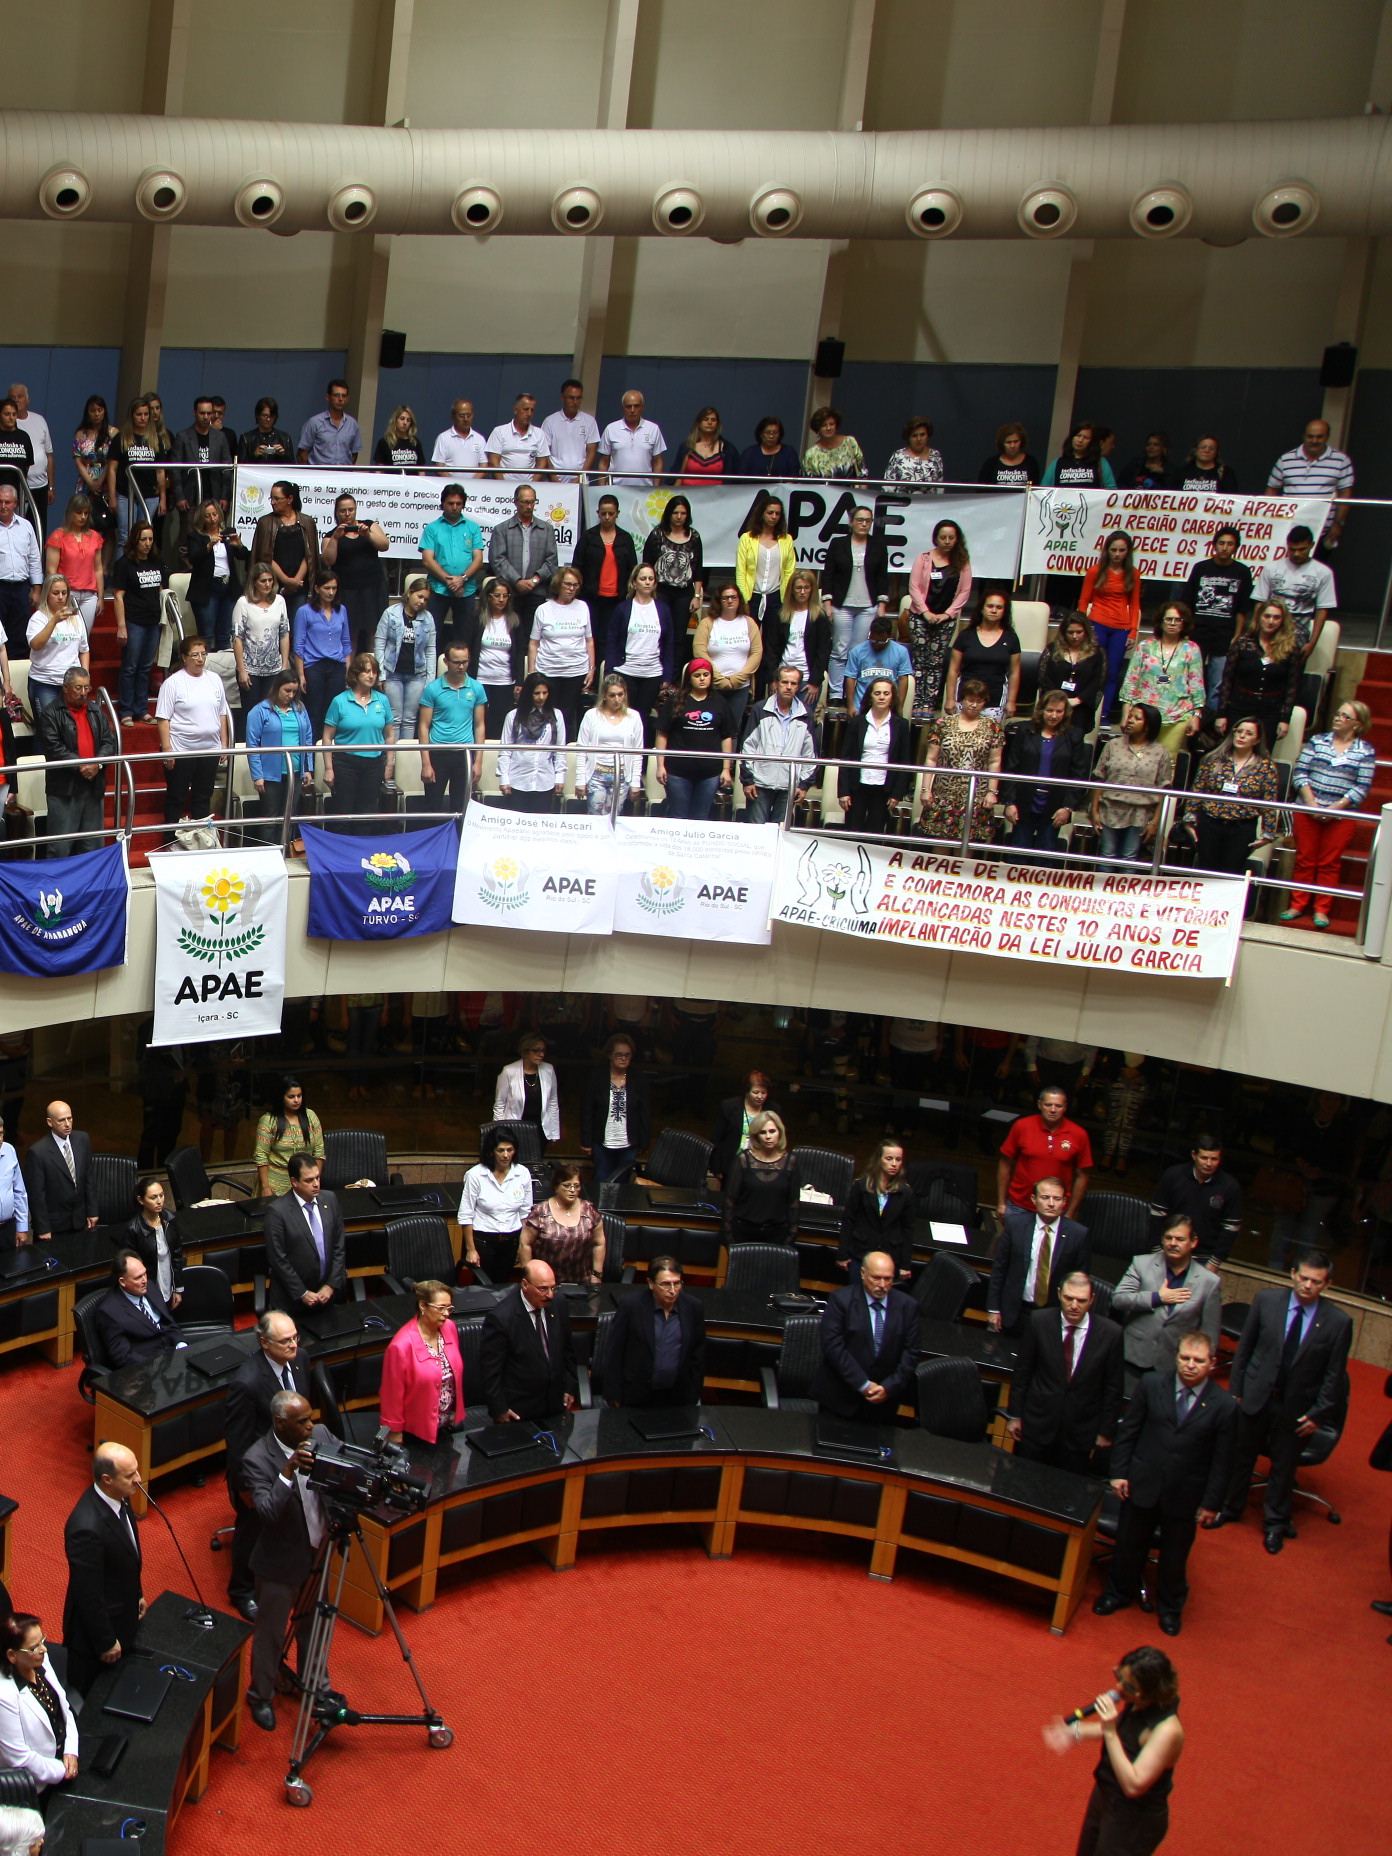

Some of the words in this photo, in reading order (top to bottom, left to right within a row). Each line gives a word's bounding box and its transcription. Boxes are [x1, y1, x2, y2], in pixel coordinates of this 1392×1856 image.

[1060, 472, 1094, 480] CONQUISTA
[303, 496, 312, 504] de
[366, 500, 386, 509] gesto
[325, 485, 337, 494] faz
[341, 486, 369, 495] sozinho:
[373, 489, 402, 498] sempre
[414, 491, 440, 500] preciso
[481, 495, 491, 503] de
[1106, 493, 1119, 508] O
[1123, 493, 1199, 512] CONSELHO
[1203, 497, 1234, 516] DAS
[1242, 501, 1298, 520] APAES
[322, 516, 332, 525] 10
[382, 521, 402, 529] vem
[404, 521, 419, 530] nos
[738, 488, 912, 547] APAE
[1101, 513, 1123, 529] DA
[1125, 514, 1178, 533] REGIÃO
[1045, 540, 1078, 552] APAE
[1176, 539, 1198, 557] OS
[1138, 561, 1158, 577] DA
[1162, 562, 1189, 578] LEI
[480, 815, 512, 827] Amigo
[515, 817, 538, 828] José
[542, 820, 557, 829] Nei
[560, 821, 592, 831] Ascari
[650, 828, 681, 838] Amigo
[683, 830, 706, 839] Julio
[708, 831, 740, 841] Garcia
[542, 876, 596, 896] APAE
[888, 851, 904, 869] A
[911, 854, 964, 876] APAE
[972, 862, 1000, 881] DE
[1103, 875, 1205, 903] AGRADECE
[697, 884, 749, 903] APAE
[883, 873, 897, 890] E
[902, 876, 1006, 905] COMEMORA
[1010, 890, 1033, 909] AS
[1037, 892, 1136, 919] CONQUISTAS
[1139, 903, 1153, 920] E
[1156, 904, 1230, 929] VITÓRIAS
[368, 895, 416, 913] APAE
[719, 902, 729, 910] Sul
[13, 914, 33, 931] APAE
[31, 926, 43, 937] DE
[362, 914, 398, 925] TURVO
[875, 894, 993, 927] ALCANÇADAS
[998, 910, 1068, 935] NESTES
[1077, 919, 1099, 938] 10
[1105, 923, 1162, 948] ANOS
[1171, 928, 1201, 949] DE
[876, 917, 993, 951] IMPLANTAÇÃO
[997, 932, 1023, 954] DA
[1028, 936, 1062, 958] LEI
[1066, 939, 1124, 965] JÚLIO
[1130, 948, 1203, 974] GARCIA
[174, 970, 264, 1006] APAE
[197, 1014, 219, 1023] Içara
[226, 1011, 239, 1020] SC
